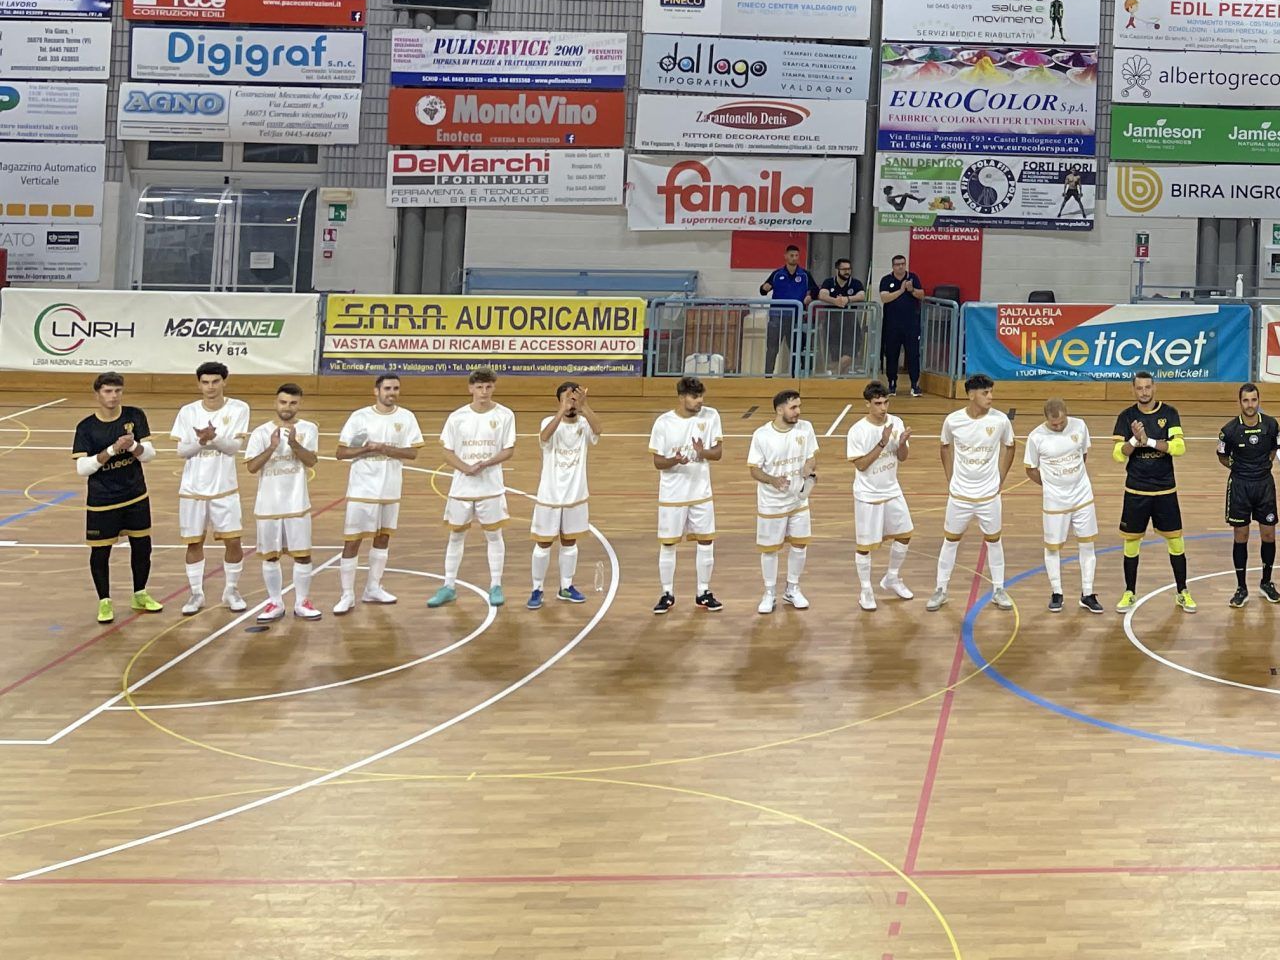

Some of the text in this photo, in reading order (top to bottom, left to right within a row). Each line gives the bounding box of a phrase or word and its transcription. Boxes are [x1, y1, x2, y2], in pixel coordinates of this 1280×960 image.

[133, 9, 198, 17] COSTRUZIONI
[1170, 1, 1212, 16] EDIL
[973, 15, 1043, 24] movimento
[168, 32, 356, 76] Digigraf s.n.c.
[433, 39, 551, 56] PULISERVICE
[554, 46, 583, 56] 2000
[708, 44, 768, 88] lago
[1159, 67, 1280, 90] albertogreco
[781, 83, 853, 93] VALDAGNO
[124, 91, 225, 115] AGNO
[453, 95, 596, 125] MondoVino
[436, 129, 482, 143] Enoteca
[1123, 123, 1202, 139] Jamieson
[44, 163, 96, 172] Automatico
[393, 153, 549, 172] DeMarchi
[21, 176, 59, 185] Verticale
[442, 176, 547, 184] FORNITURE
[657, 160, 814, 224] famila
[1171, 183, 1224, 198] BIRRA
[681, 216, 812, 226] supermercati & superstore
[456, 306, 637, 331] AUTORICAMBI
[1000, 308, 1028, 316] SALTA
[52, 321, 135, 338] LNRH
[194, 320, 280, 337] CHANNEL
[1000, 318, 1054, 326] ALLA CASSA
[1000, 327, 1020, 335] CON
[198, 341, 248, 356] sky 814
[332, 339, 375, 350] VASTA
[379, 339, 429, 350] GAMMA
[433, 340, 446, 350] DI
[450, 340, 505, 351] RICAMBI
[520, 340, 596, 351] ACCESSORI
[600, 340, 636, 351] AUTO
